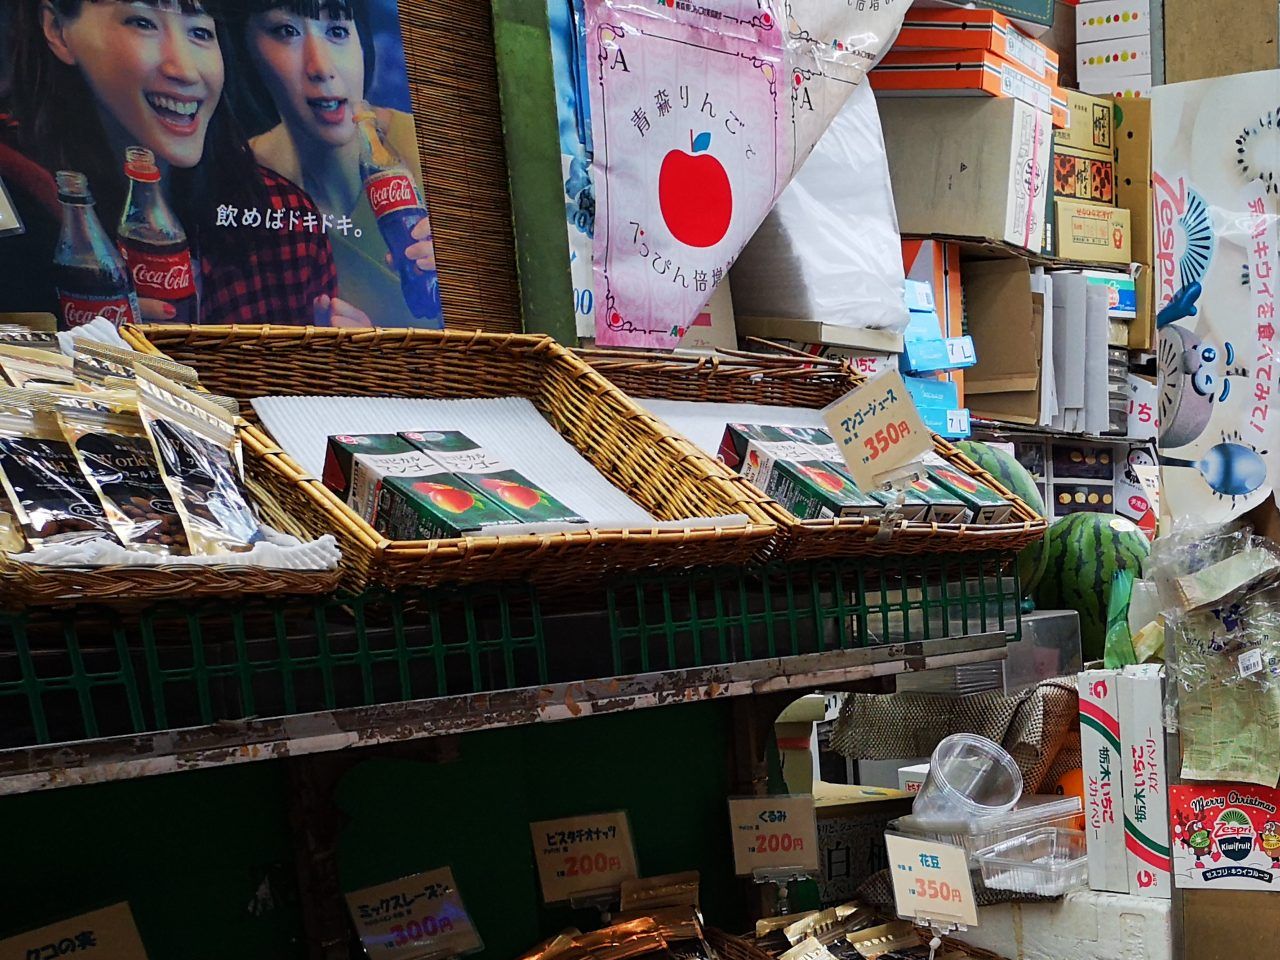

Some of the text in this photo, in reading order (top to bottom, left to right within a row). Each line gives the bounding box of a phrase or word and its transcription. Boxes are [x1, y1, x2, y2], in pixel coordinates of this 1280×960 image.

[610, 49, 630, 73] A
[800, 87, 814, 111] A
[369, 178, 413, 206] Coca-Cola
[215, 204, 363, 238] 飲めばドキドキ。
[133, 263, 190, 289] Coca-Cola
[840, 388, 898, 433] マンゴージュース
[864, 420, 911, 460] 350円
[1146, 727, 1159, 794] スカイベリー
[1099, 746, 1114, 824] 栃木いちご
[1131, 745, 1147, 823] 栃木いちご
[1088, 776, 1100, 840] スカイベリー
[1191, 790, 1276, 813] Merry Christmas
[759, 810, 787, 824] くるみ
[1214, 822, 1252, 838] Zespri
[757, 834, 803, 853] 200円
[1221, 842, 1251, 851] Kiwifruit
[565, 853, 621, 877] 200円
[919, 853, 941, 869] 花豆
[915, 878, 962, 902] 350円
[390, 914, 455, 949] 300円
